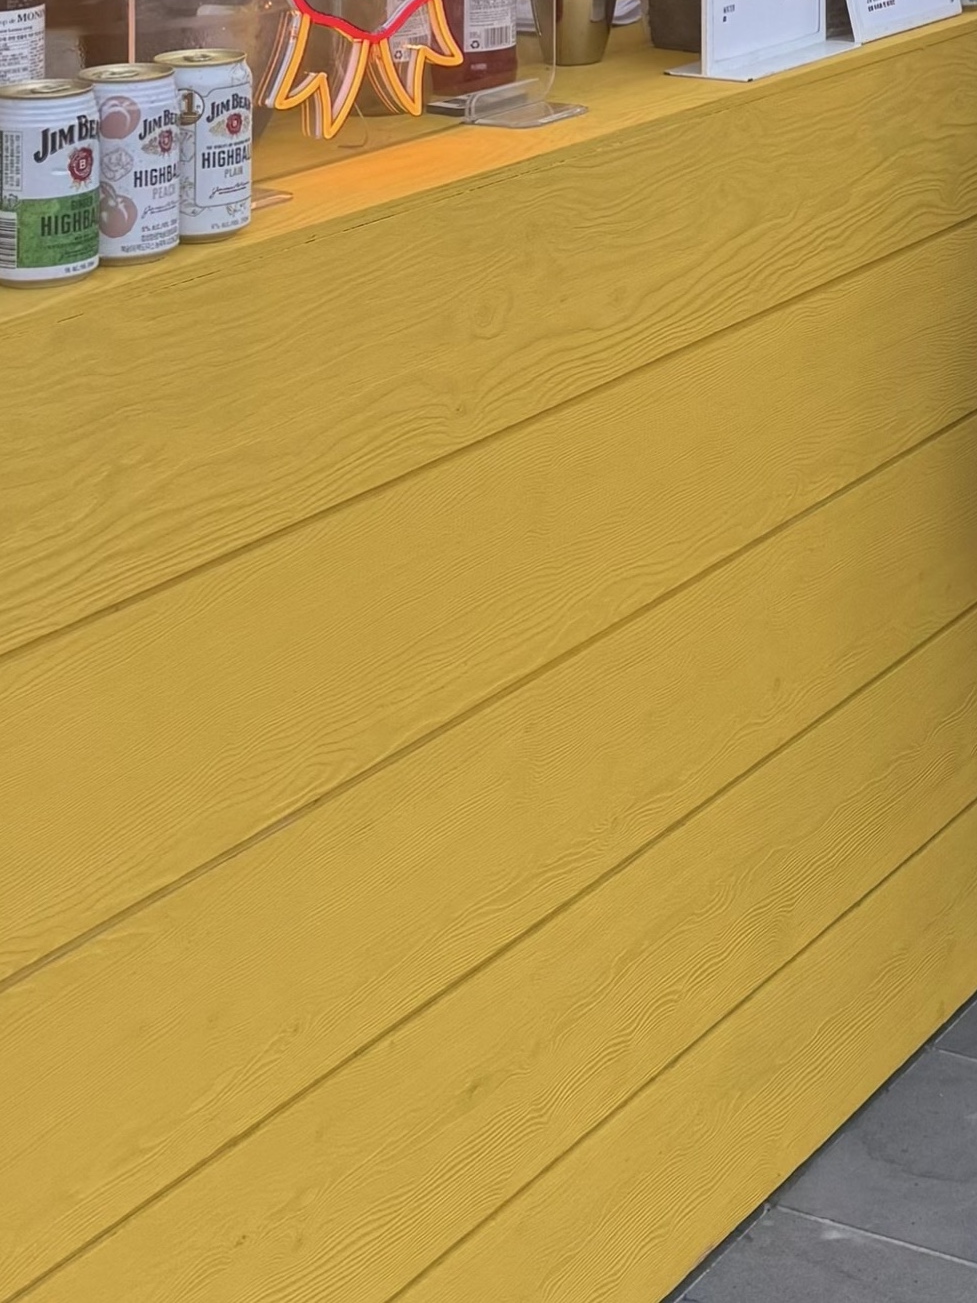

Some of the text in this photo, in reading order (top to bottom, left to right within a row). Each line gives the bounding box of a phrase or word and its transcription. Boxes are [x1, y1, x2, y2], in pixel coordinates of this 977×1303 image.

[17, 8, 44, 22] MON
[139, 109, 178, 140] JIM BE
[206, 99, 231, 123] JIM
[33, 124, 75, 164] JIM
[41, 207, 98, 236] HIGHBA
